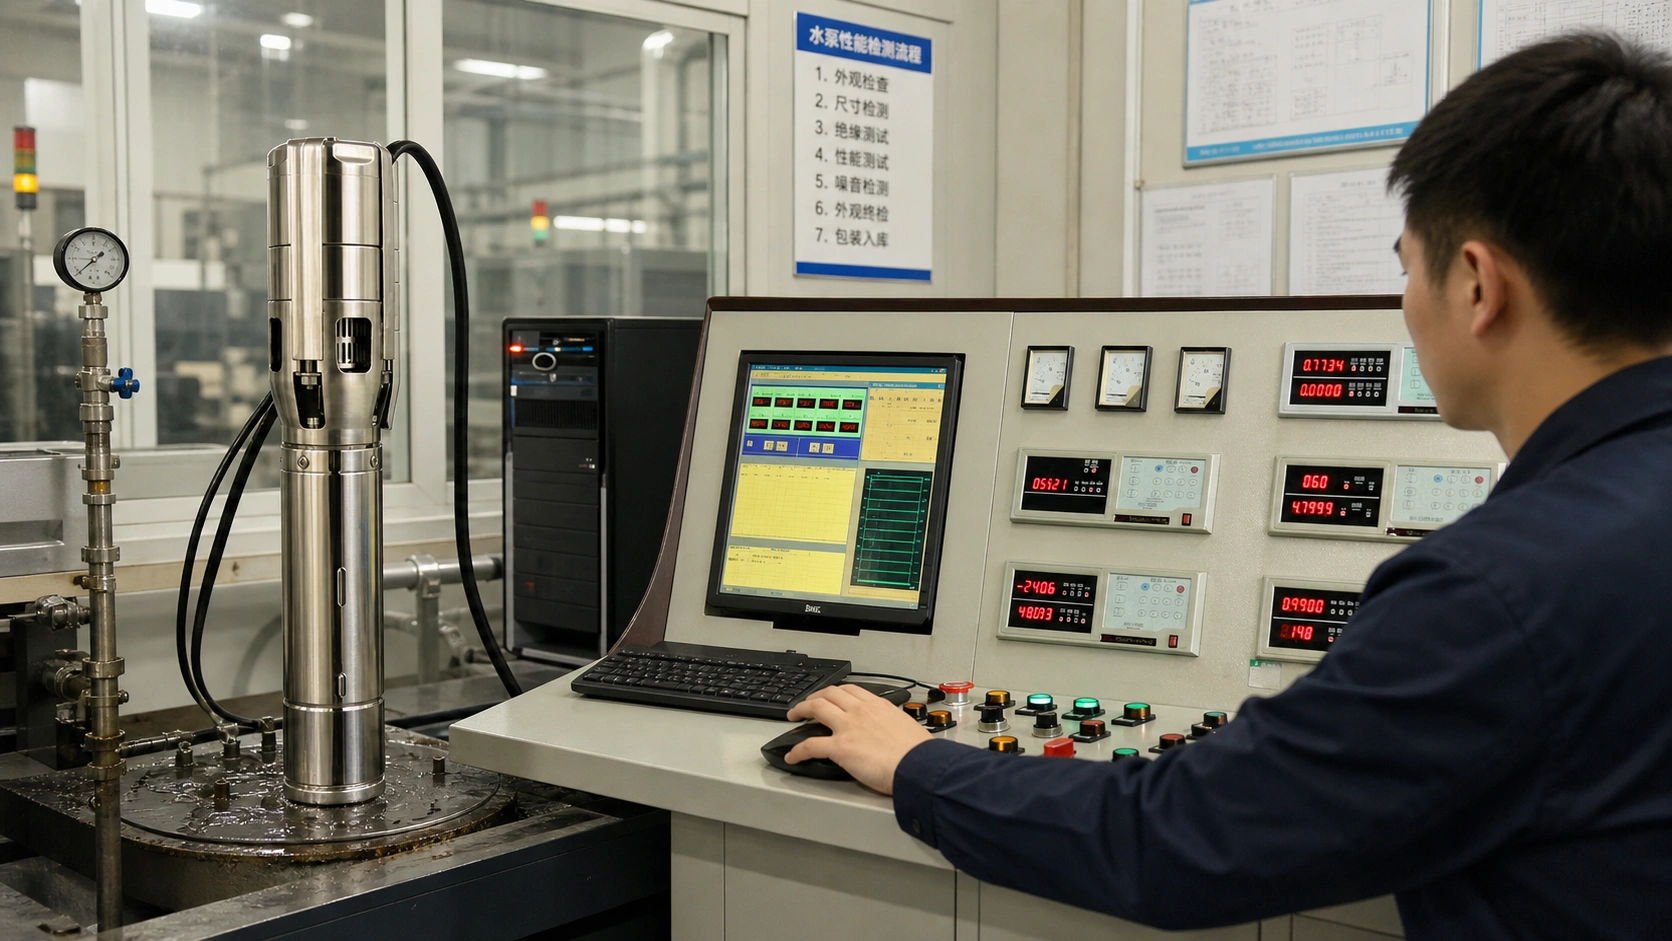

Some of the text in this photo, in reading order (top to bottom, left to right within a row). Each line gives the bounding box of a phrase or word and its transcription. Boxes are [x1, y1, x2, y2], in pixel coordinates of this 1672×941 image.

[809, 25, 922, 65] 水泵性能检测流程
[816, 66, 889, 93] 1. 外观检查
[815, 93, 889, 119] 2. 尺寸检测
[815, 120, 889, 145] 3. 绝缘测试
[815, 147, 889, 171] 4. 性能测试
[815, 173, 889, 197] 5. 噪音检测
[815, 200, 889, 222] 6. 外观终检
[815, 227, 889, 248] 7. 包装入库
[1302, 474, 1328, 489] 060
